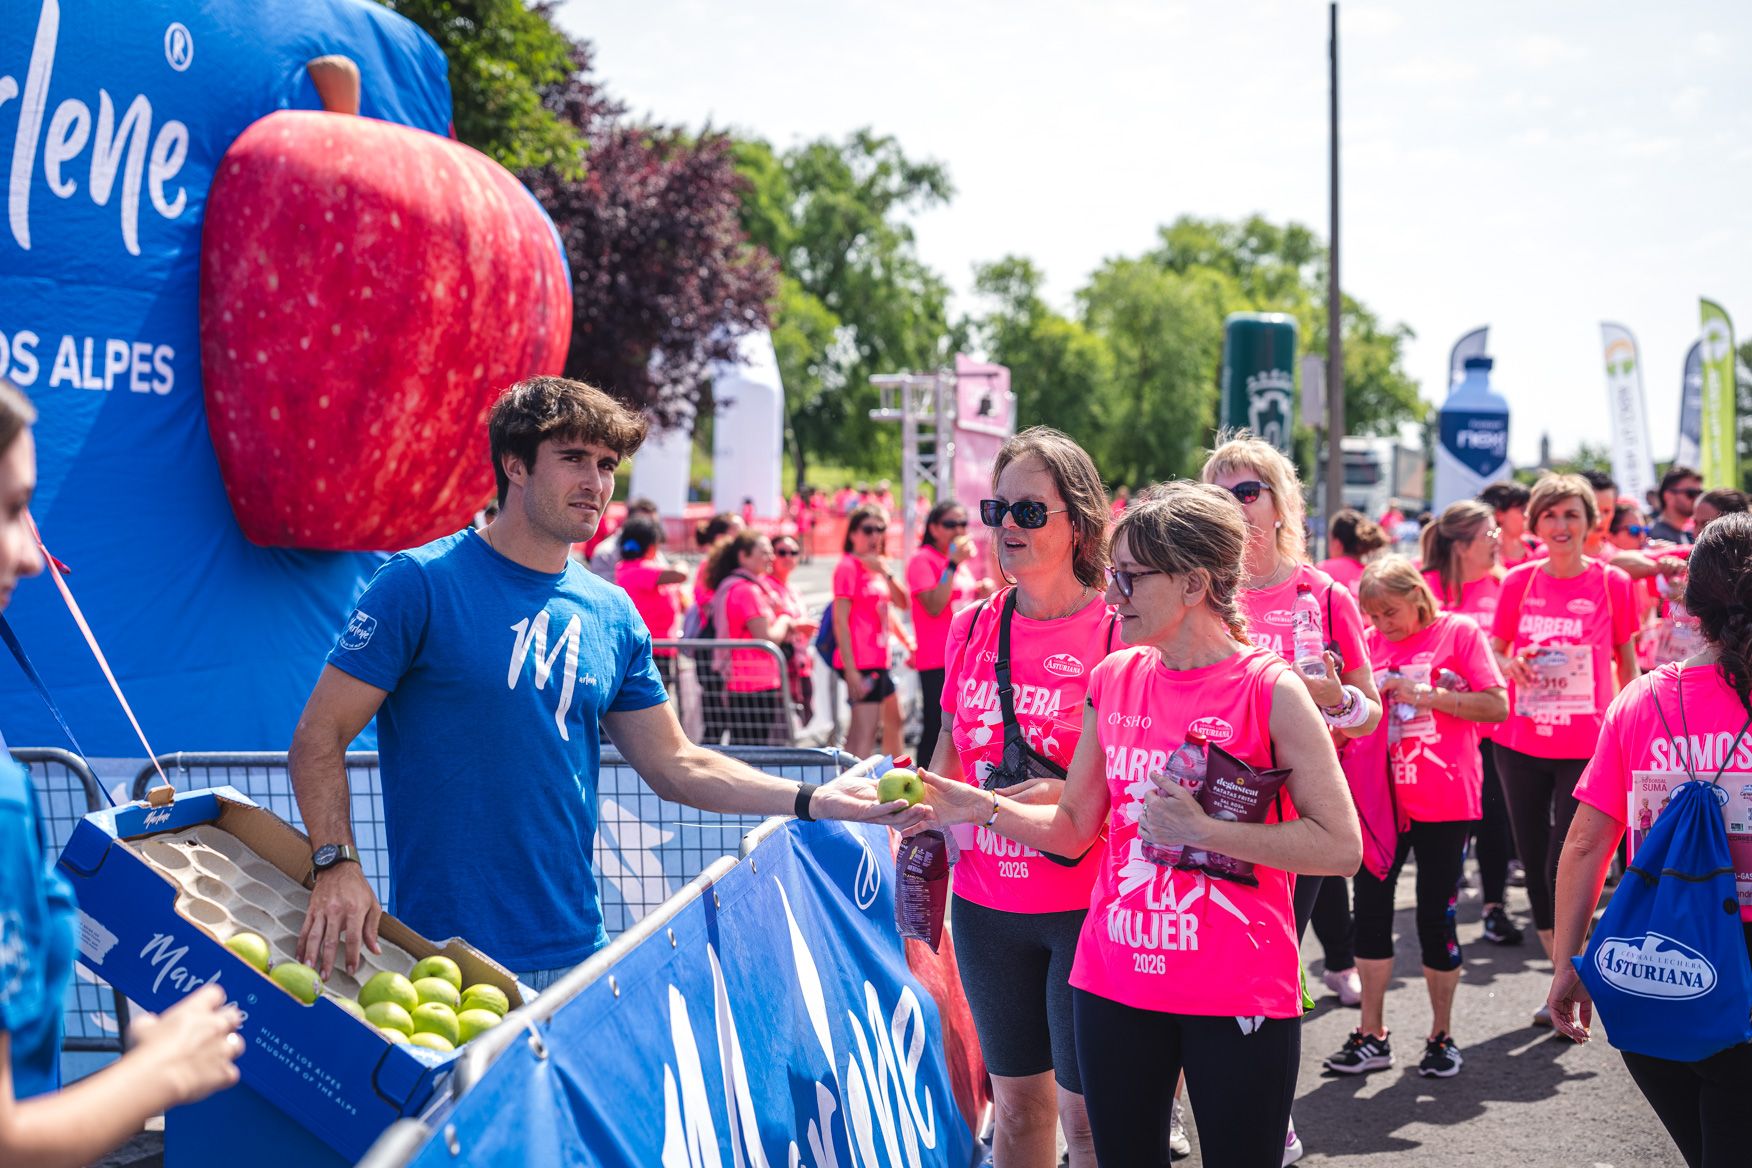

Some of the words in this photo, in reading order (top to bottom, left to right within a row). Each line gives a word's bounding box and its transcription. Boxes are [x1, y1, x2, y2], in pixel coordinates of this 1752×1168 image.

[49, 334, 175, 396] ALPES
[1108, 712, 1152, 730] OYSHO
[1193, 723, 1230, 738] ASTURIANA
[1213, 786, 1236, 799] PATATAS
[1237, 793, 1257, 804] FRITAS
[1642, 783, 1667, 792] SUMA
[1213, 800, 1222, 808] DEL
[1220, 798, 1229, 806] SAL
[1230, 801, 1244, 810] ROSA
[998, 861, 1029, 879] 2026
[1107, 907, 1199, 951] MUJER
[1132, 953, 1166, 974] 2026
[1601, 947, 1704, 988] ASTURIANA
[1657, 957, 1702, 970] LECHERA
[261, 1027, 280, 1044] HIJA
[282, 1043, 295, 1055] DE
[296, 1053, 313, 1068] LOS
[314, 1067, 341, 1090] ALPES
[256, 1036, 300, 1072] DAUGHTER
[302, 1072, 315, 1082] OF
[316, 1081, 333, 1097] THE
[335, 1097, 357, 1116] ALPS
